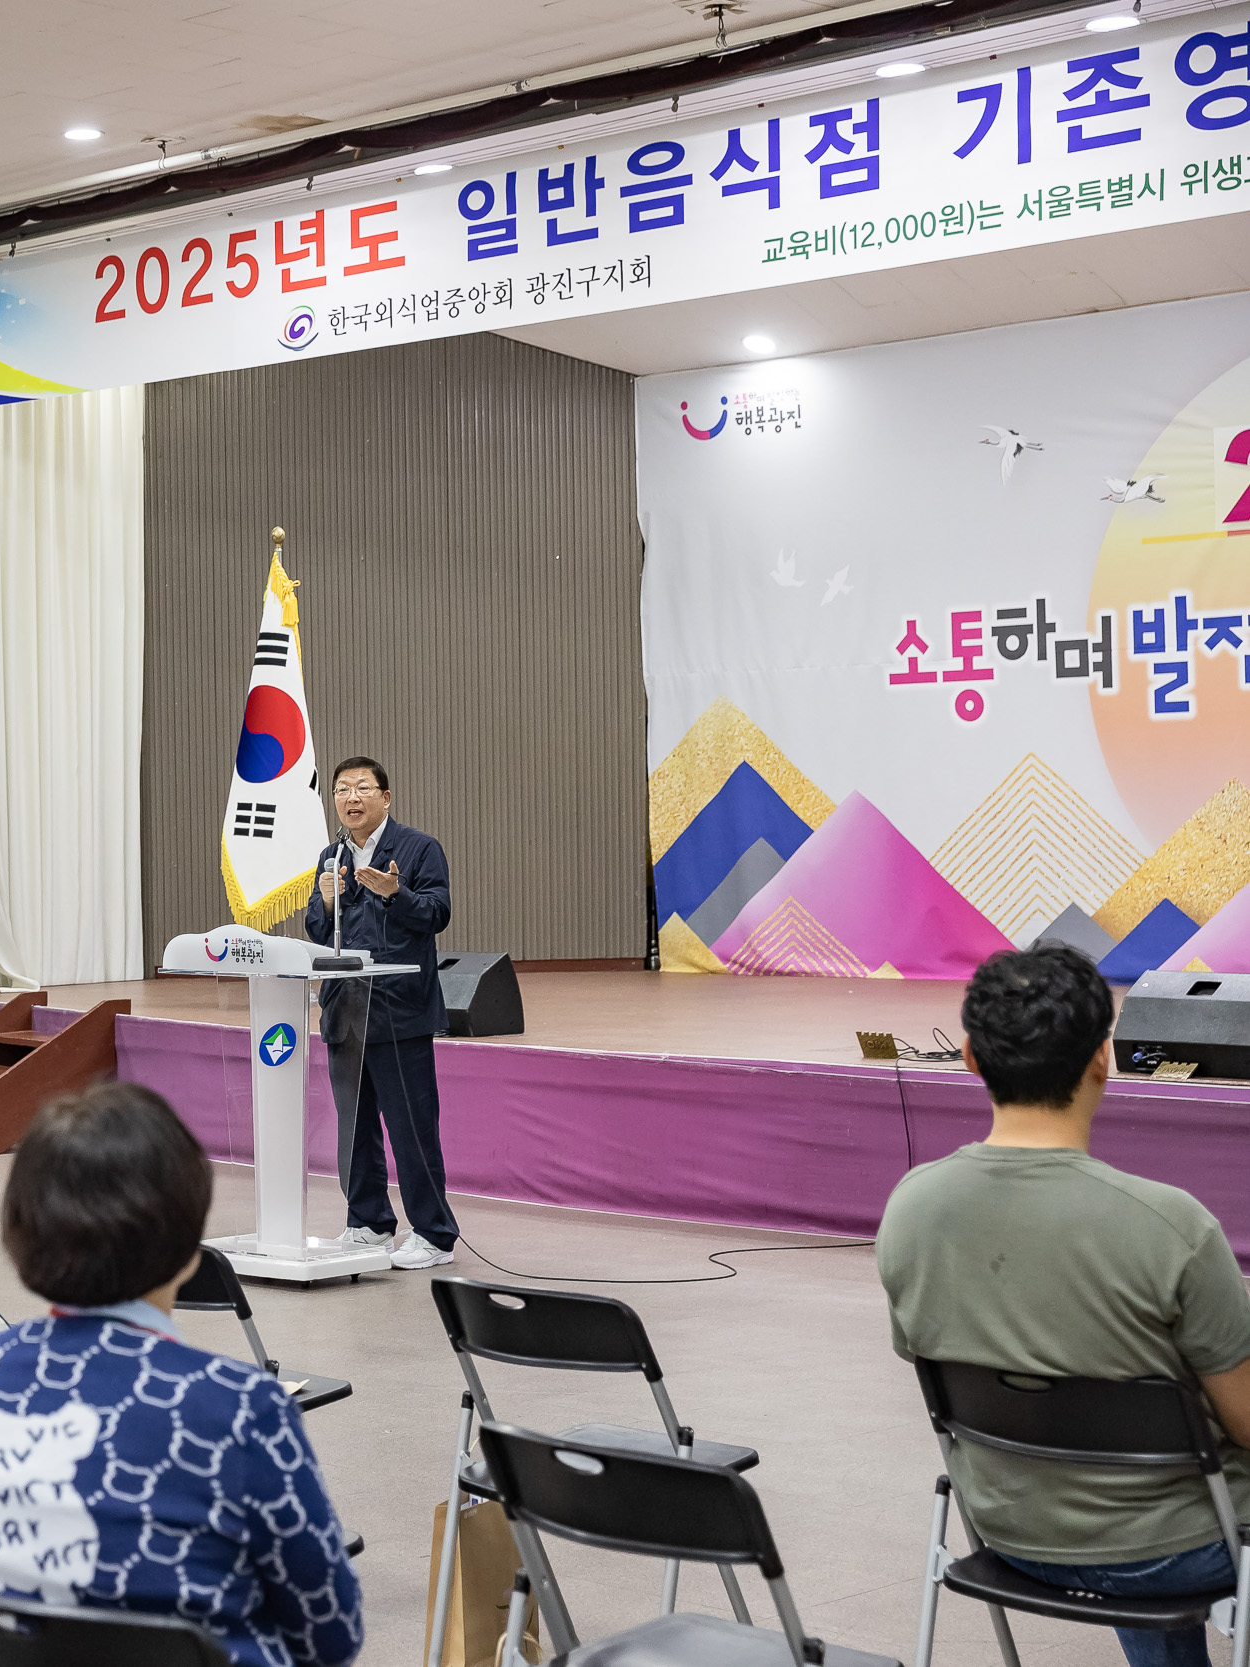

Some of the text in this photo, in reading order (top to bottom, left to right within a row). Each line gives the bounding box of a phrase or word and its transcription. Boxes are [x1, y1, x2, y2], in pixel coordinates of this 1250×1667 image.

[95, 200, 406, 324] 2025년도
[457, 97, 880, 262] 일반음식점
[953, 46, 1150, 165] 기존
[761, 154, 1250, 264] 교육비(12,000원)는 서울특별시 위생
[328, 254, 653, 337] 한국외식업중앙회 광진구지회
[735, 404, 801, 436] 행복광진
[889, 598, 1113, 722] 소통하며
[231, 947, 264, 964] 행복광진
